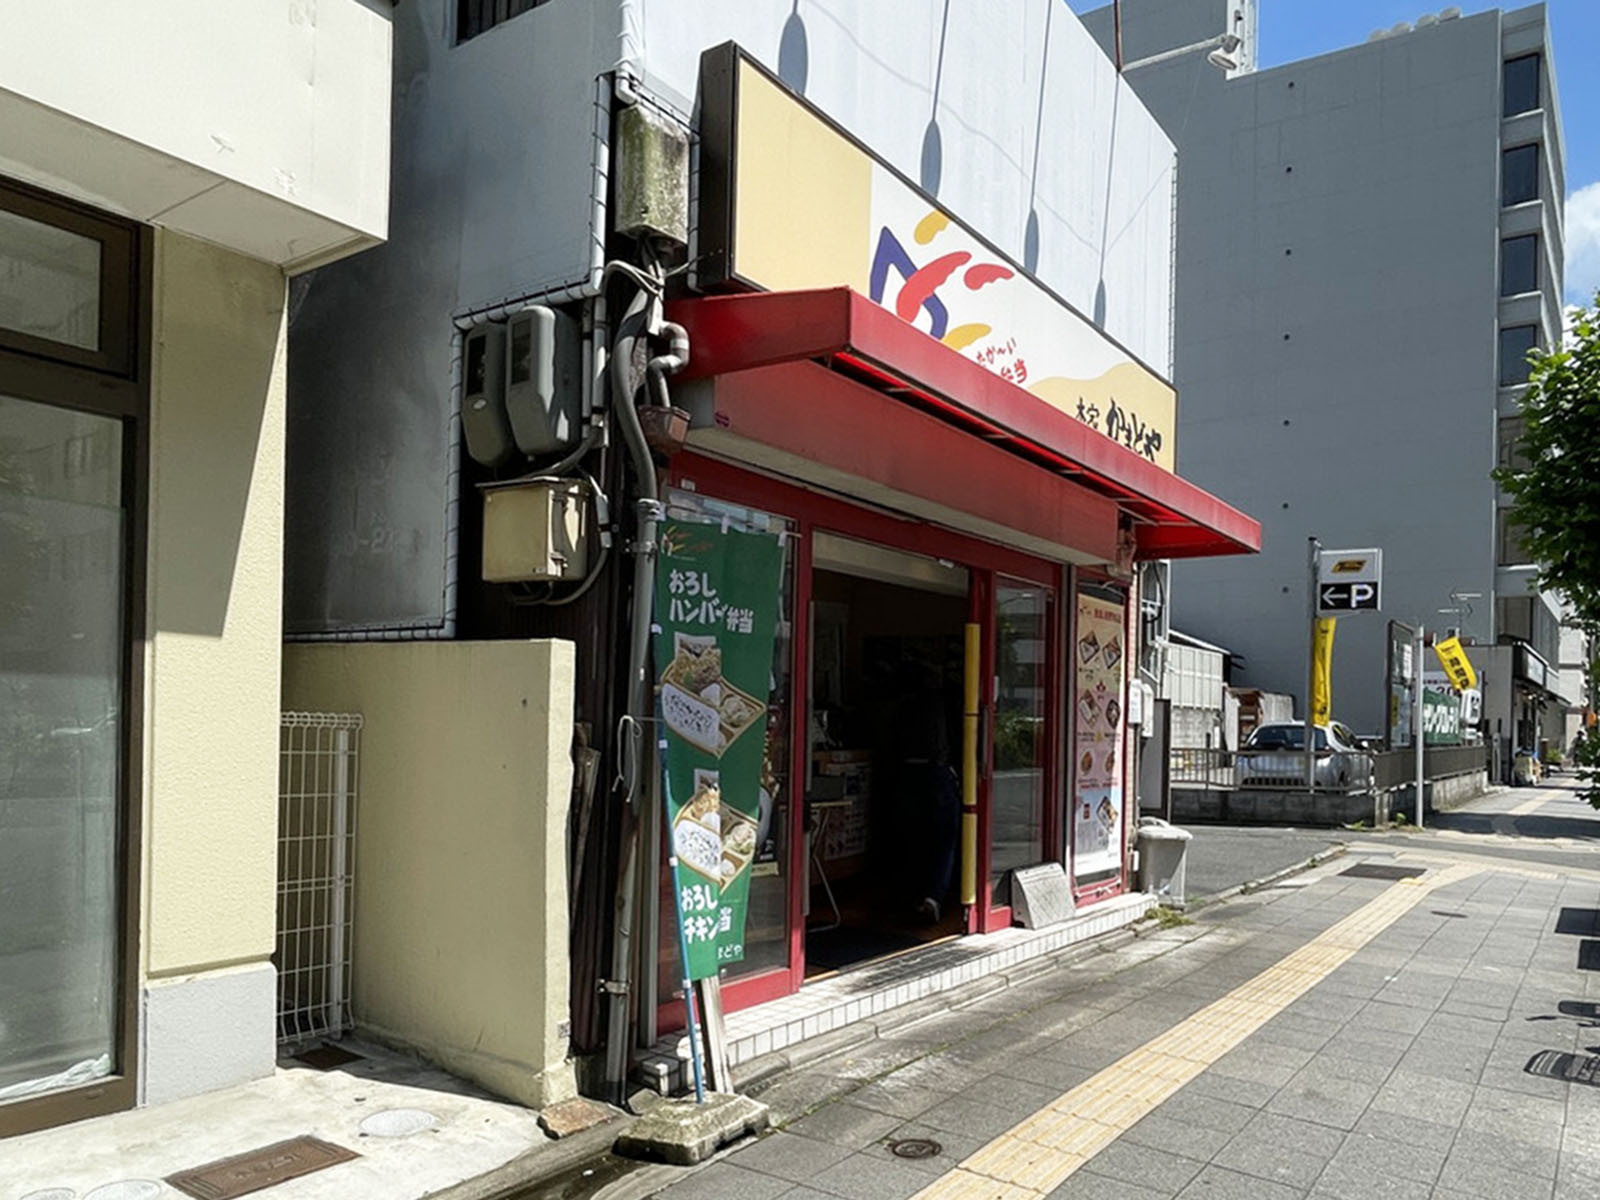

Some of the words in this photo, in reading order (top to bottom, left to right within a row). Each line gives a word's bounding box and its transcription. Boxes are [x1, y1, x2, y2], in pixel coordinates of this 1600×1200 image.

[668, 568, 717, 598] おろし
[1351, 584, 1374, 608] P
[681, 884, 718, 912] おろし
